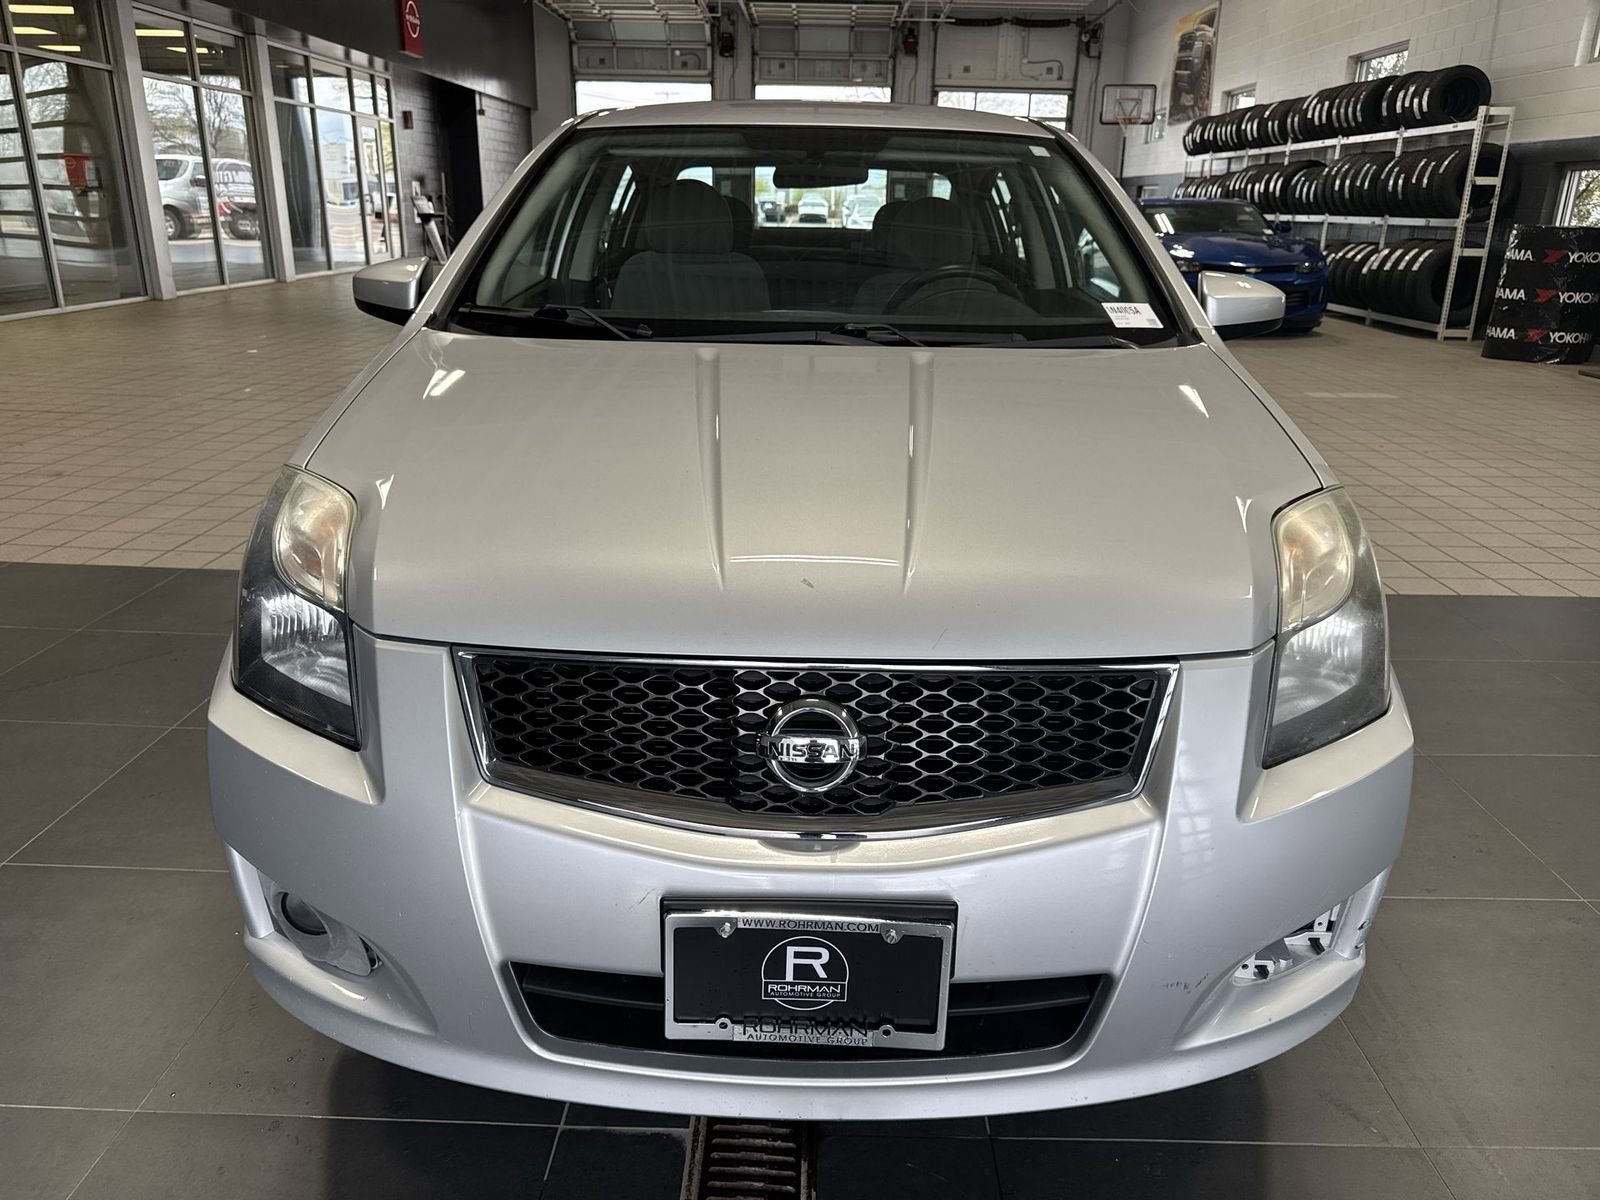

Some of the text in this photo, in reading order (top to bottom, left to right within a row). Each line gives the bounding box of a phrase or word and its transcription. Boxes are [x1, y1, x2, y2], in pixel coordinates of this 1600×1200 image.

[768, 741, 856, 758] NISSAN
[742, 918, 880, 932] WWW.ROHRMAN.COM
[785, 946, 830, 981] R
[768, 984, 841, 993] ROHRMAN
[743, 1016, 868, 1037] ROHRMAN
[747, 1034, 868, 1046] AUTOMOTIVE GROUP
